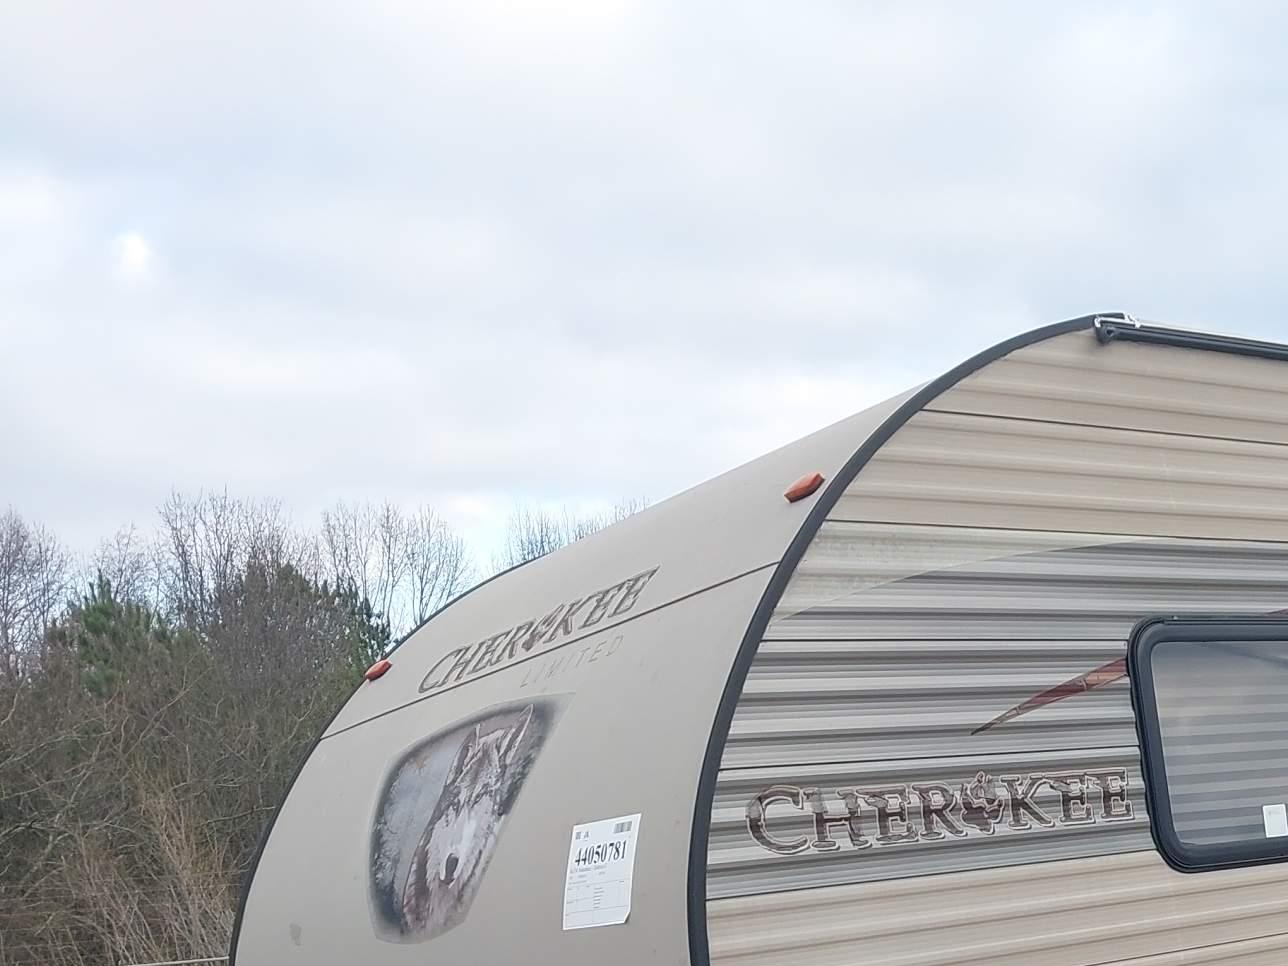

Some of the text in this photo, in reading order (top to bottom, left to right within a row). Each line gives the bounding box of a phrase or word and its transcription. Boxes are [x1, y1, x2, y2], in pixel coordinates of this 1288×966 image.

[418, 564, 660, 693] CHEROKEE
[520, 634, 624, 688] LIMITED
[746, 768, 1136, 855] CHEROKEE
[574, 840, 627, 866] 44050781
